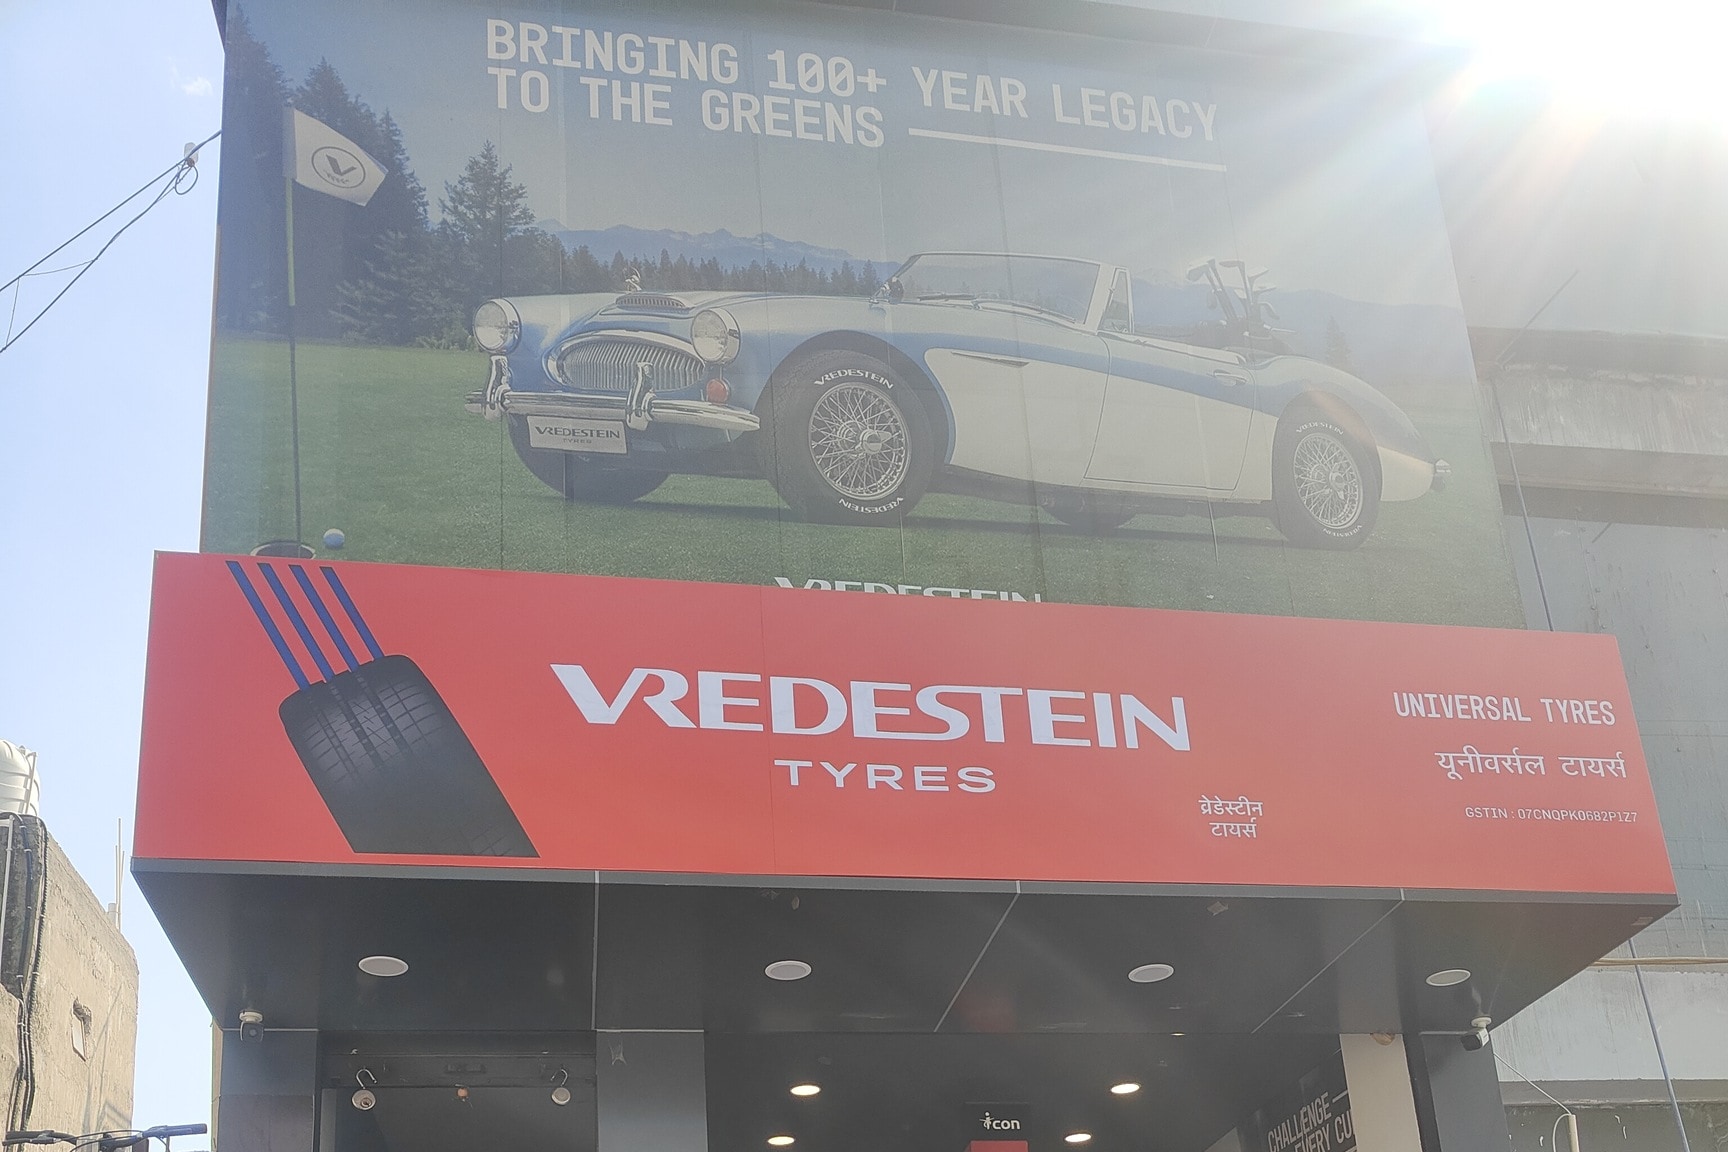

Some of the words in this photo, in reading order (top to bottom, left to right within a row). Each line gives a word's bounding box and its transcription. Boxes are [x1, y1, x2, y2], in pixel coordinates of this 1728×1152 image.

[486, 18, 740, 84] BRINGING
[766, 49, 887, 98] 100+
[912, 65, 1028, 118] YEAR
[1052, 84, 1218, 142] LEGACY
[487, 66, 550, 114] TO
[579, 75, 673, 127] THE
[701, 90, 885, 148] GREENS
[813, 368, 894, 390] VREDESTEIN
[534, 426, 620, 439] VREDESTEIN
[549, 662, 1190, 752] VREDESTEIN
[1393, 691, 1532, 723] UNIVERSAL
[1541, 697, 1616, 727] TYRES
[774, 759, 997, 794] TYRES
[1434, 744, 1546, 781] यूनीवर्सल
[1557, 749, 1628, 780] टायर्स
[1209, 817, 1257, 839] टायर्स
[1465, 807, 1508, 819] GSTIN
[1334, 1110, 1356, 1144] CU
